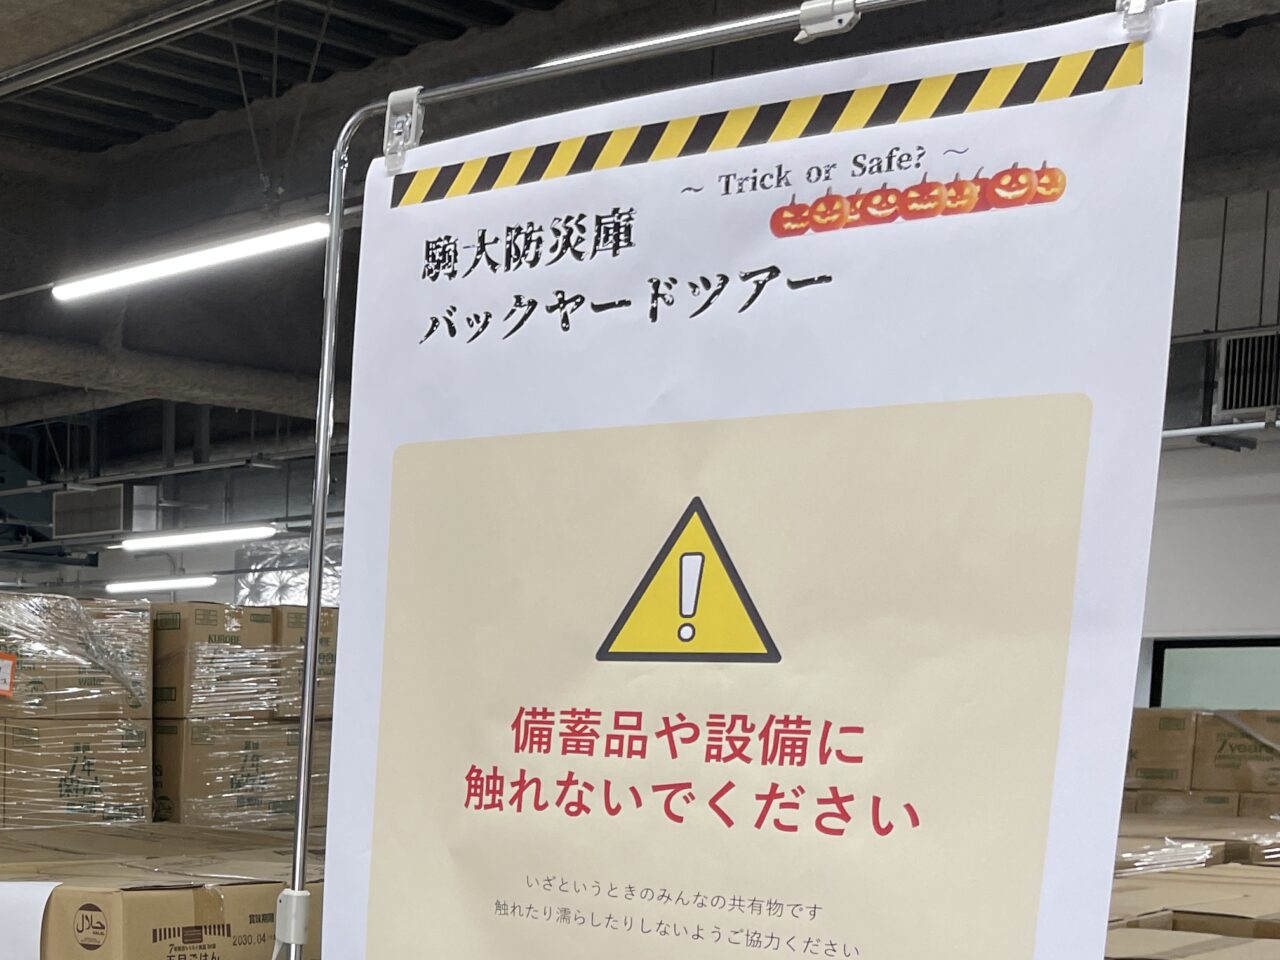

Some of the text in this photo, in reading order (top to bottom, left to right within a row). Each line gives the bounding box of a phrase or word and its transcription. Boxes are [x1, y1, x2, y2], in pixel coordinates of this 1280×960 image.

[717, 145, 927, 197] Trick or Safe?
[421, 207, 637, 282] 駒大防災庫
[419, 264, 833, 344] バックヤードツアー
[510, 705, 866, 767] 備蓄品や設備に
[463, 764, 921, 837] 触れないでください
[493, 898, 861, 959] 触れたり濡らしたりしないようご協力ください
[525, 874, 823, 921] いざというときのみんなの共有物です
